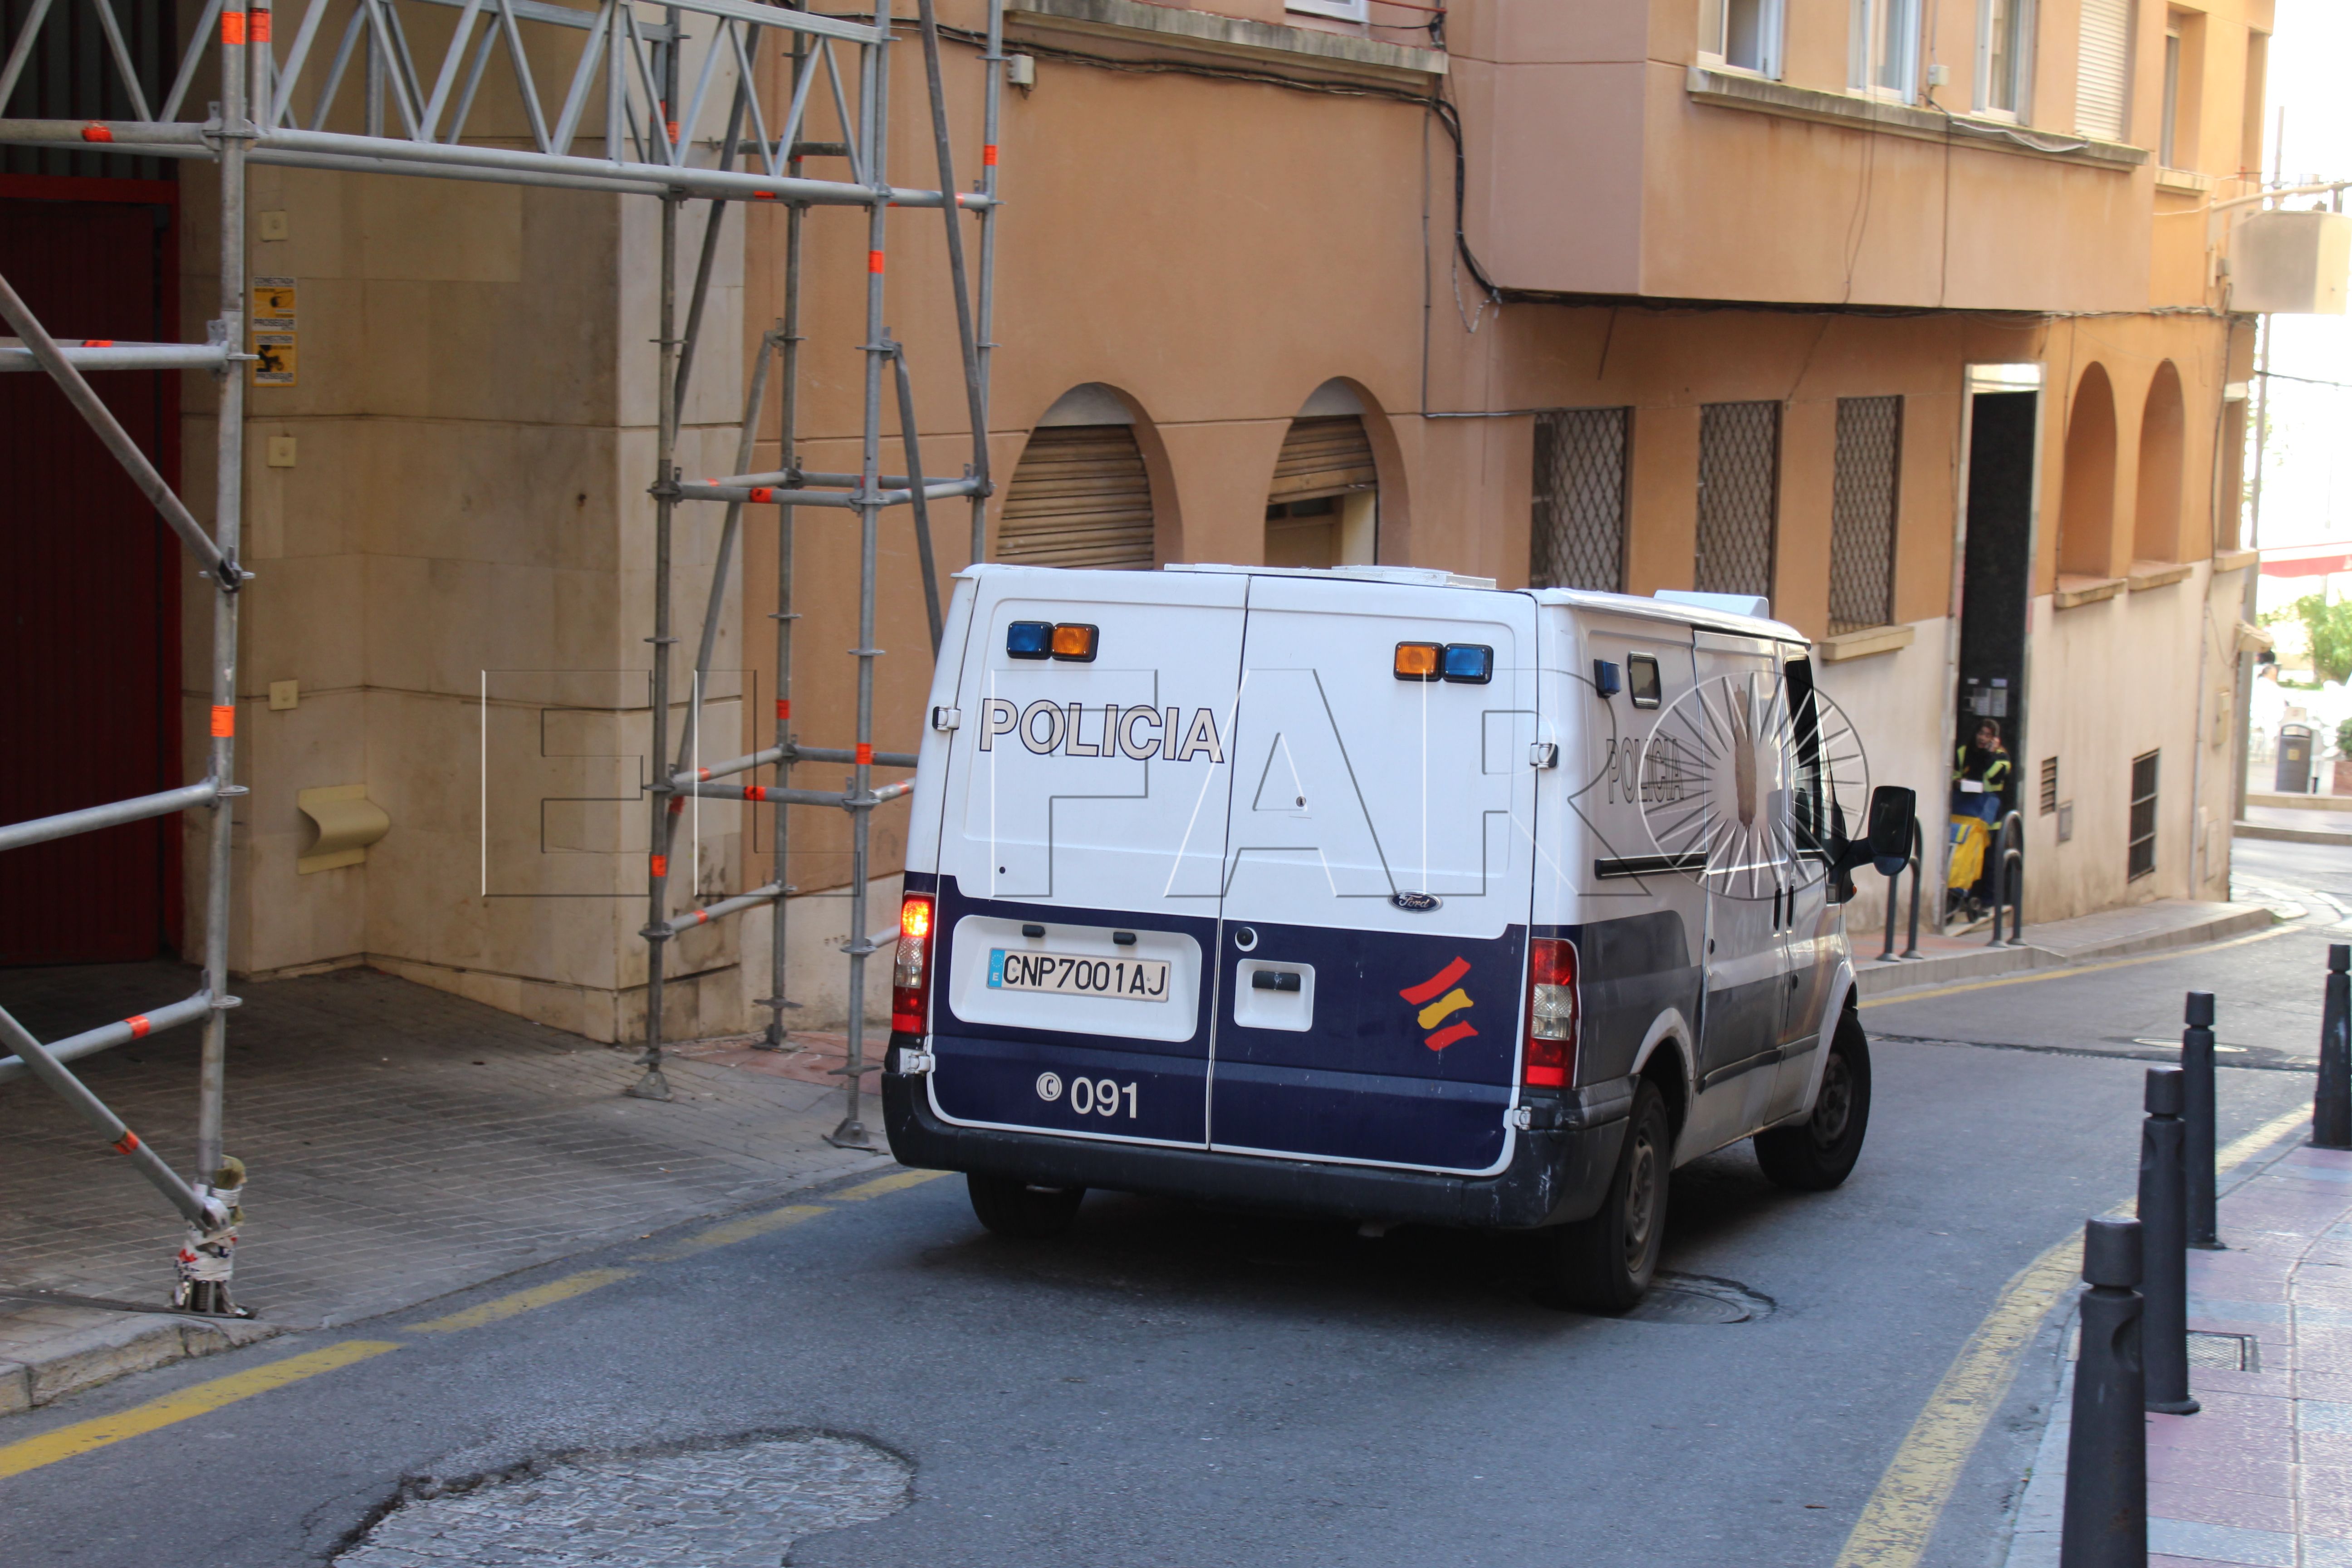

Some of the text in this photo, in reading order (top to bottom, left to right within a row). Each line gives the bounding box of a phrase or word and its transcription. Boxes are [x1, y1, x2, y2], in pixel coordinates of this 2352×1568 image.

[254, 318, 294, 327] PROSEGUR
[979, 698, 1225, 764] POLICIA
[1606, 736, 1685, 804] POLICIA
[1398, 892, 1431, 908] Ford
[992, 955, 1166, 996] E CNP7001AJ
[1071, 1077, 1137, 1119] 091
